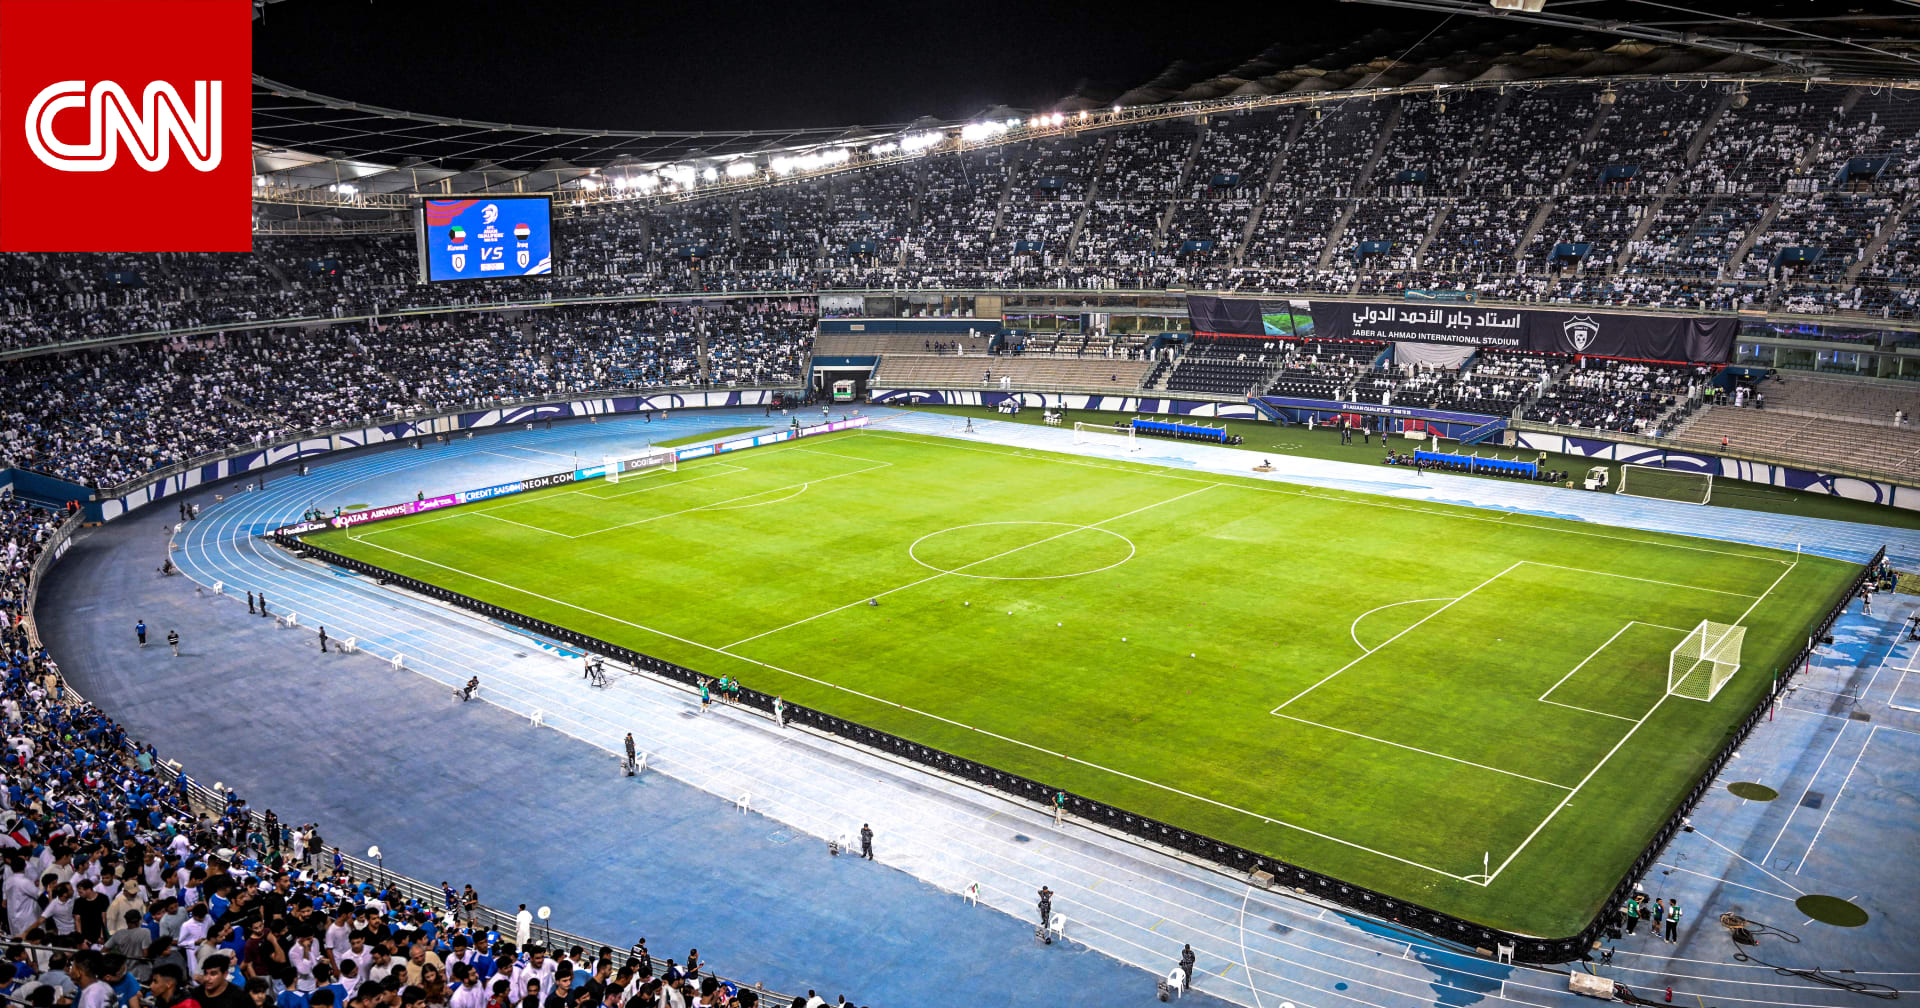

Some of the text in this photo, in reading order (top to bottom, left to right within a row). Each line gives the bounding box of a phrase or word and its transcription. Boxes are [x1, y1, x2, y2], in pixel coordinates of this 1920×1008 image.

[481, 247, 504, 260] VS
[1353, 306, 1520, 330] استاد جابر الأحمد الدولي
[1352, 329, 1520, 347] JABER AL AHMAD INTERNATIONAL STADIUM
[522, 473, 574, 490] NEOM.COM
[465, 483, 521, 501] CREDIT SAISON
[340, 505, 404, 525] QATAR AIRWAYS
